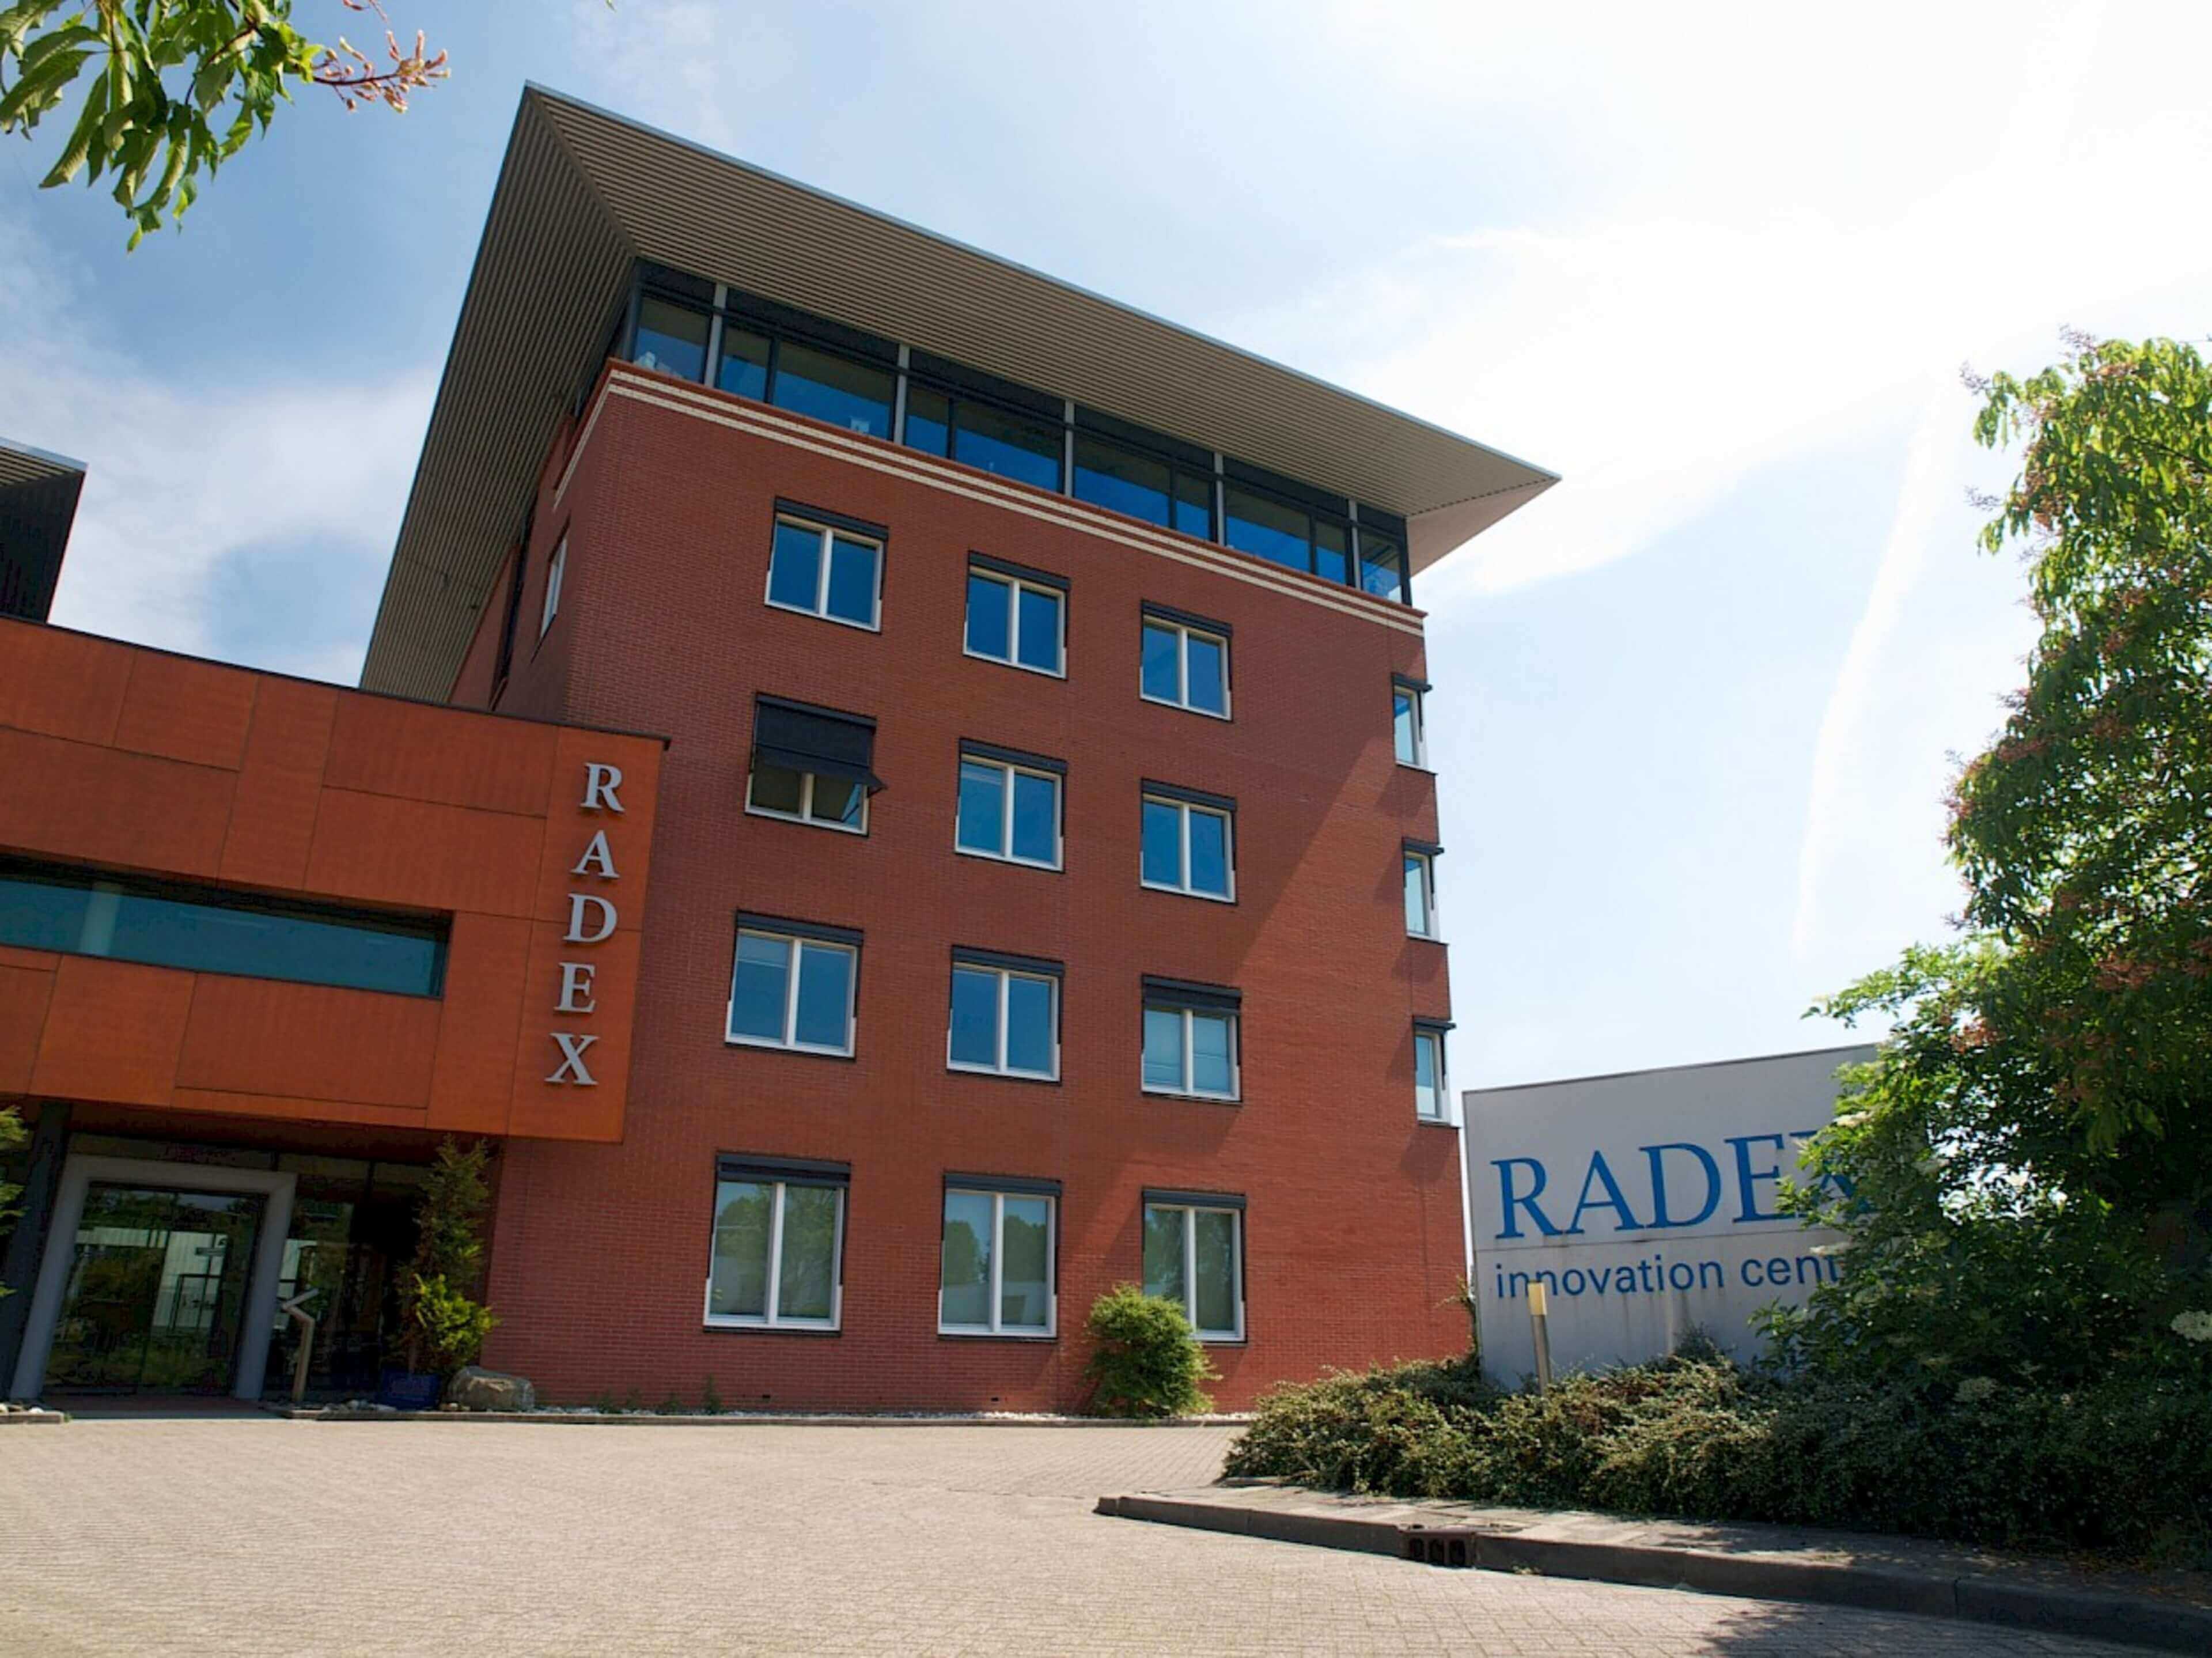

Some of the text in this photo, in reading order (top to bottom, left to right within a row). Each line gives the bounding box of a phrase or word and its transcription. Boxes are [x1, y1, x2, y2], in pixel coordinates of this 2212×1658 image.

[544, 762, 625, 1087] RADEX
[1496, 1254, 1840, 1299] innovation cent
